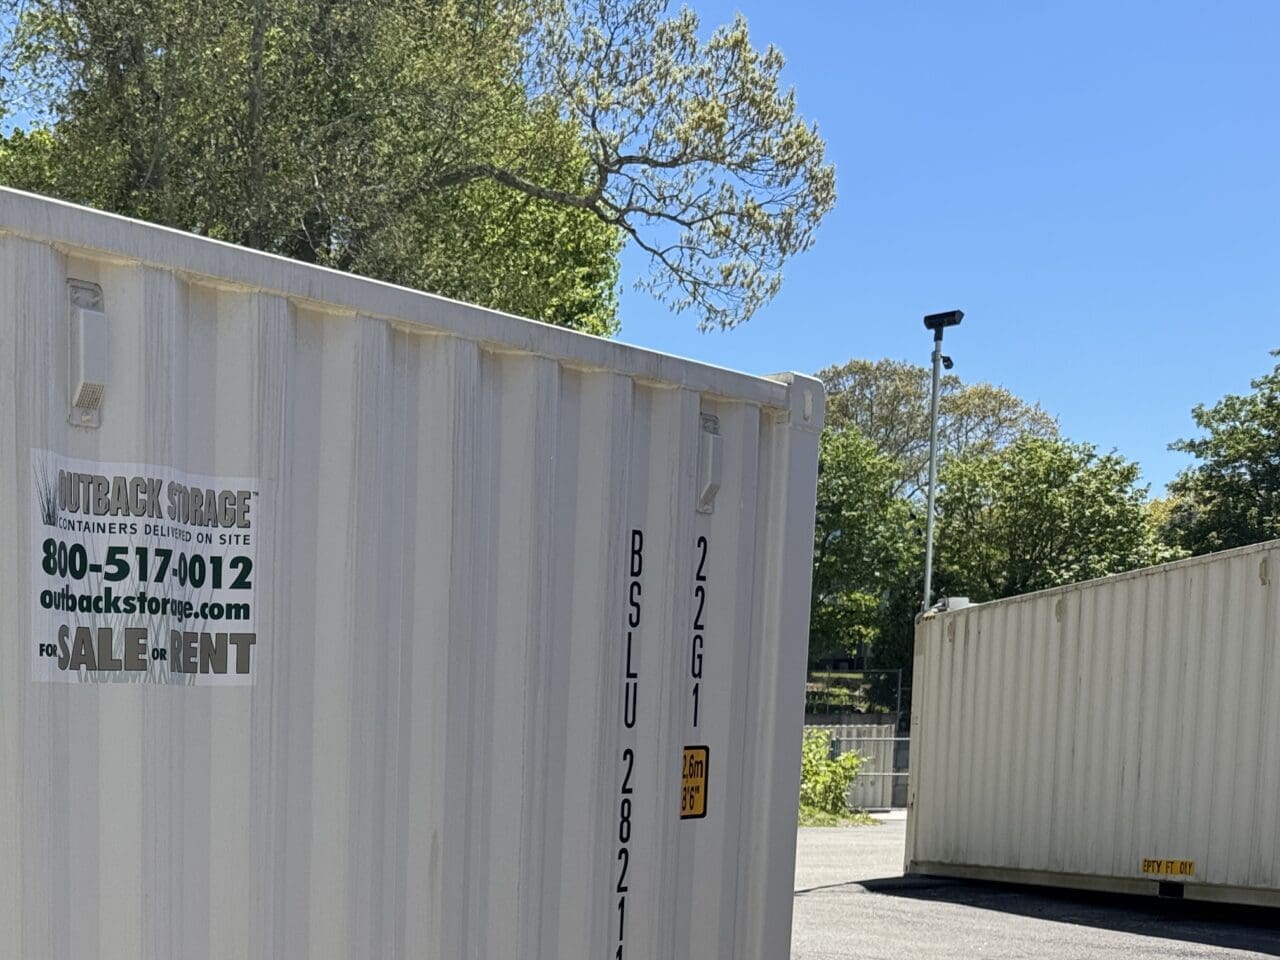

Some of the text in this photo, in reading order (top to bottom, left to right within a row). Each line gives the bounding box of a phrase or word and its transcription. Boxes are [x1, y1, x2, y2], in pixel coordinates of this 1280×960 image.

[59, 470, 251, 528] OUTBACK STORAGE
[59, 518, 250, 545] CONTAINERS DELIVERED ON SITE
[42, 538, 253, 589] 800-517-0012
[40, 585, 250, 622] outbackstorage.com
[624, 530, 643, 728] BSLU
[39, 625, 256, 674] FOR SALE OR RENT
[692, 536, 708, 727] 22G1
